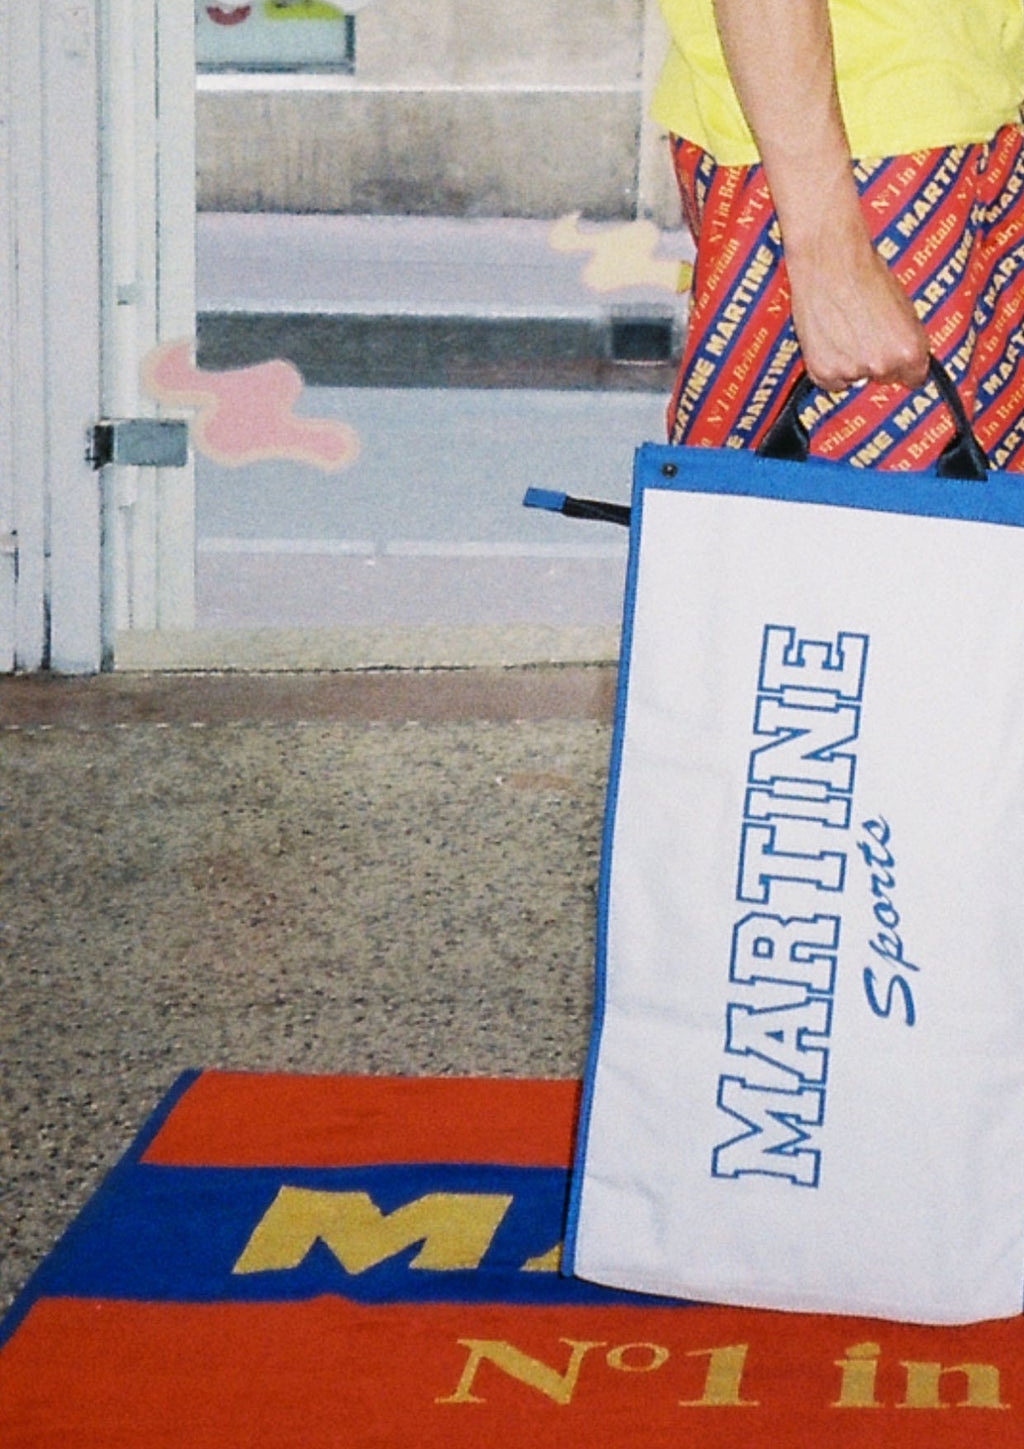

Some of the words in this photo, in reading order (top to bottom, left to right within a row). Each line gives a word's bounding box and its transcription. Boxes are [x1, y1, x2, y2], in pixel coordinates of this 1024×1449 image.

[912, 213, 958, 268] Britain
[705, 244, 774, 357] MARTINE
[732, 327, 769, 380] Britain
[737, 339, 799, 431] MARTINE
[711, 623, 870, 1188] MARTINE
[864, 814, 921, 1027] Sports
[829, 1340, 1012, 1410] in
